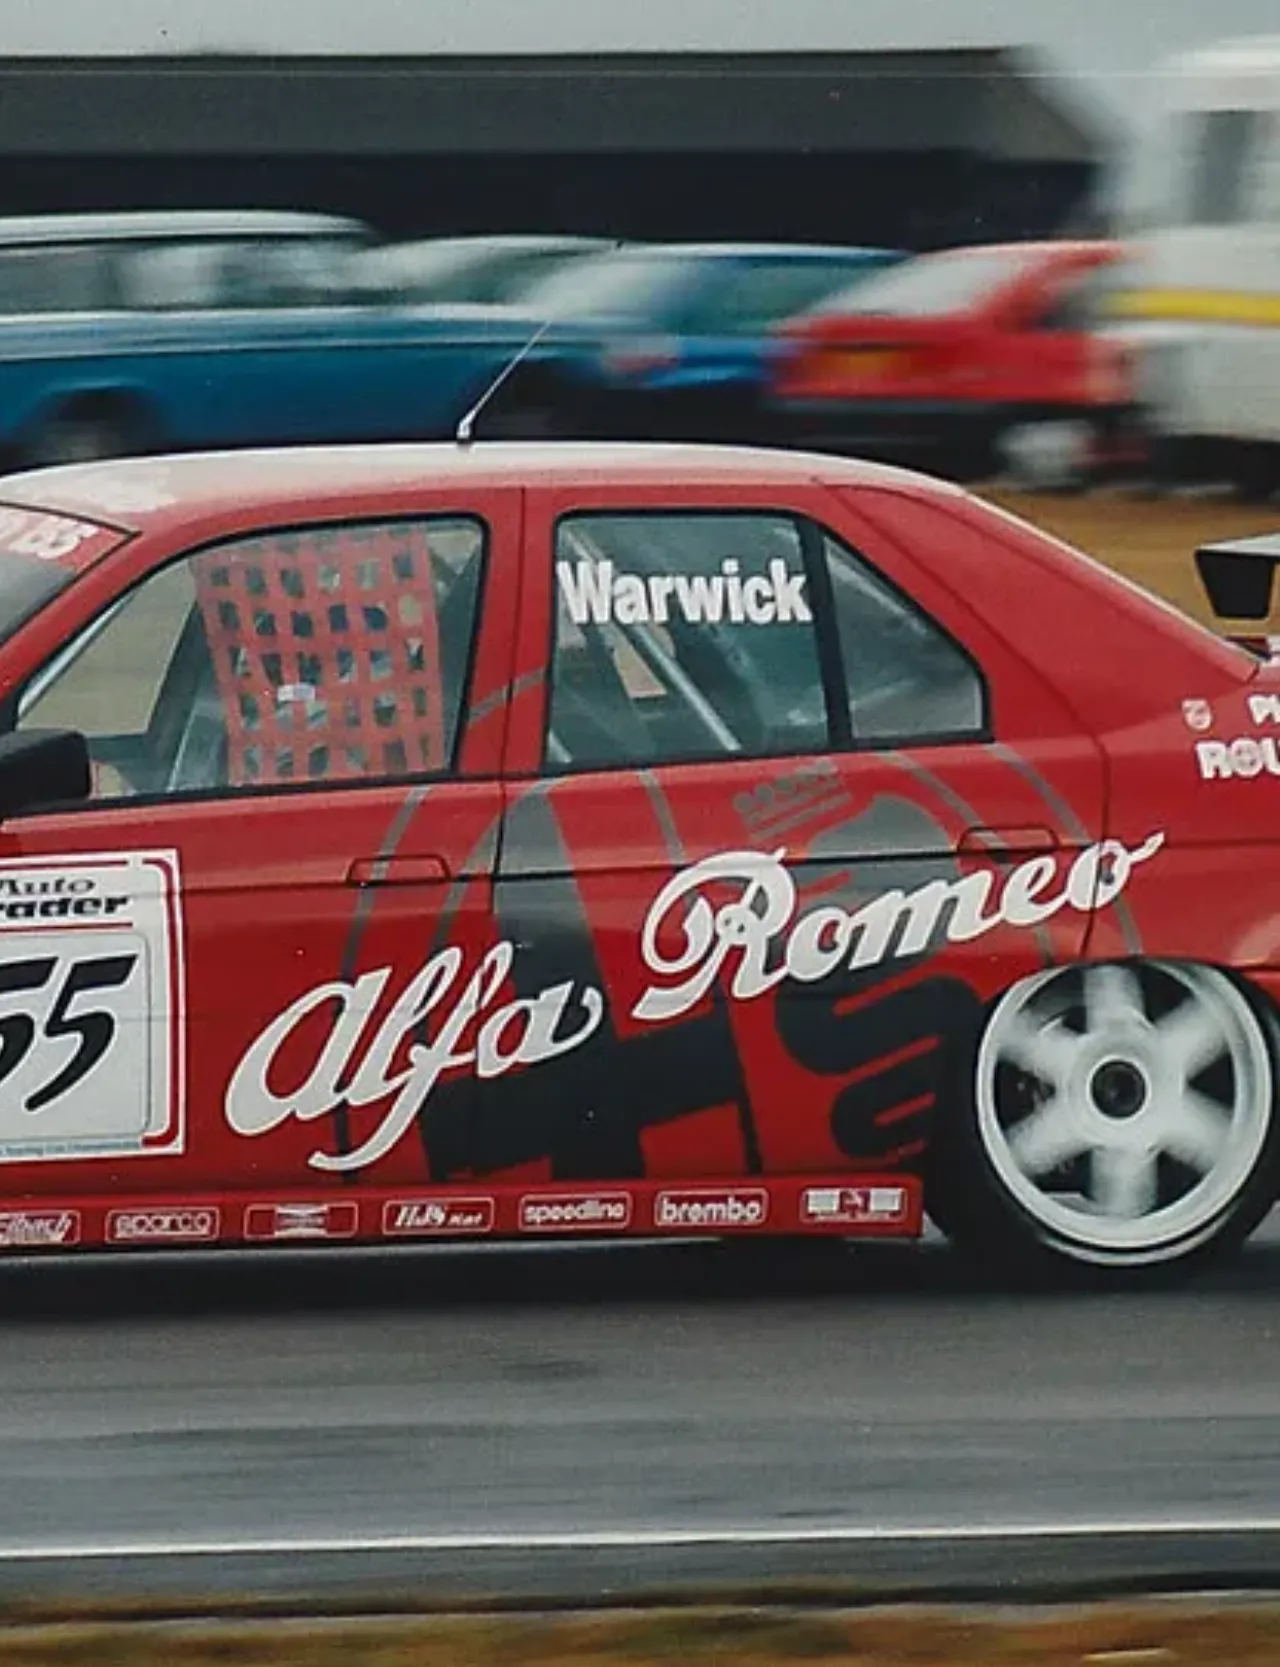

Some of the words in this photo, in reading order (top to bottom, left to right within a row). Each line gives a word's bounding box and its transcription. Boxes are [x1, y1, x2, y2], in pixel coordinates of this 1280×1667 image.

[556, 557, 813, 625] Warwick
[222, 941, 606, 1174] Alfa
[633, 830, 1167, 1021] Romeo
[523, 1199, 625, 1223] speedline
[660, 1196, 761, 1222] brembo
[115, 1211, 211, 1239] sparco
